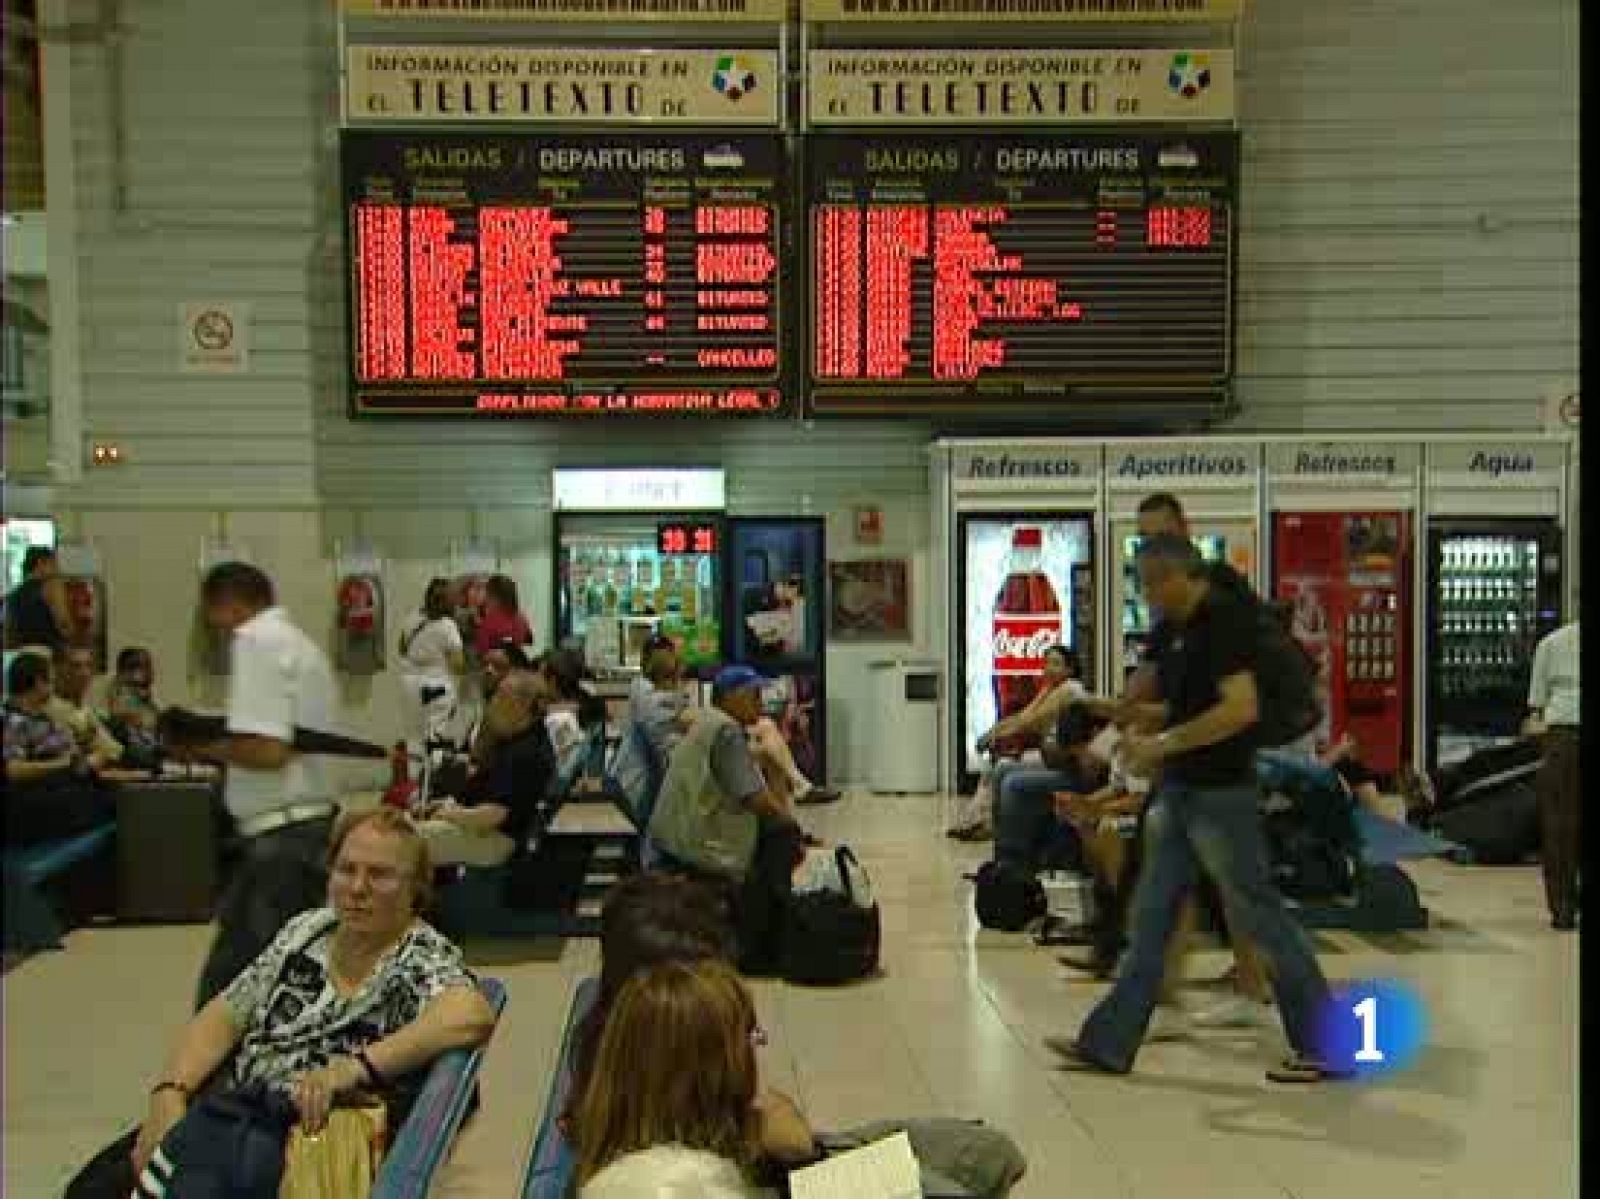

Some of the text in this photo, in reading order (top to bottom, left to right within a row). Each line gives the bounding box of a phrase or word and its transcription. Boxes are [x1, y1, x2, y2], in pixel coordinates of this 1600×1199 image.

[529, 58, 648, 77] DISPONIBLE
[661, 59, 688, 77] EN
[985, 57, 1103, 76] DISPONIBLE
[409, 79, 644, 115] TELETEXTO
[869, 80, 1098, 114] TELETEXTO
[403, 147, 502, 170] SALIDAS
[539, 147, 685, 171] DEPARTURES
[996, 147, 1139, 171] DEPARTURES
[968, 454, 1081, 478] Refrescos
[1118, 453, 1248, 480] Aperitivos
[1294, 452, 1396, 475] Refrescos
[1468, 449, 1535, 478] Agua
